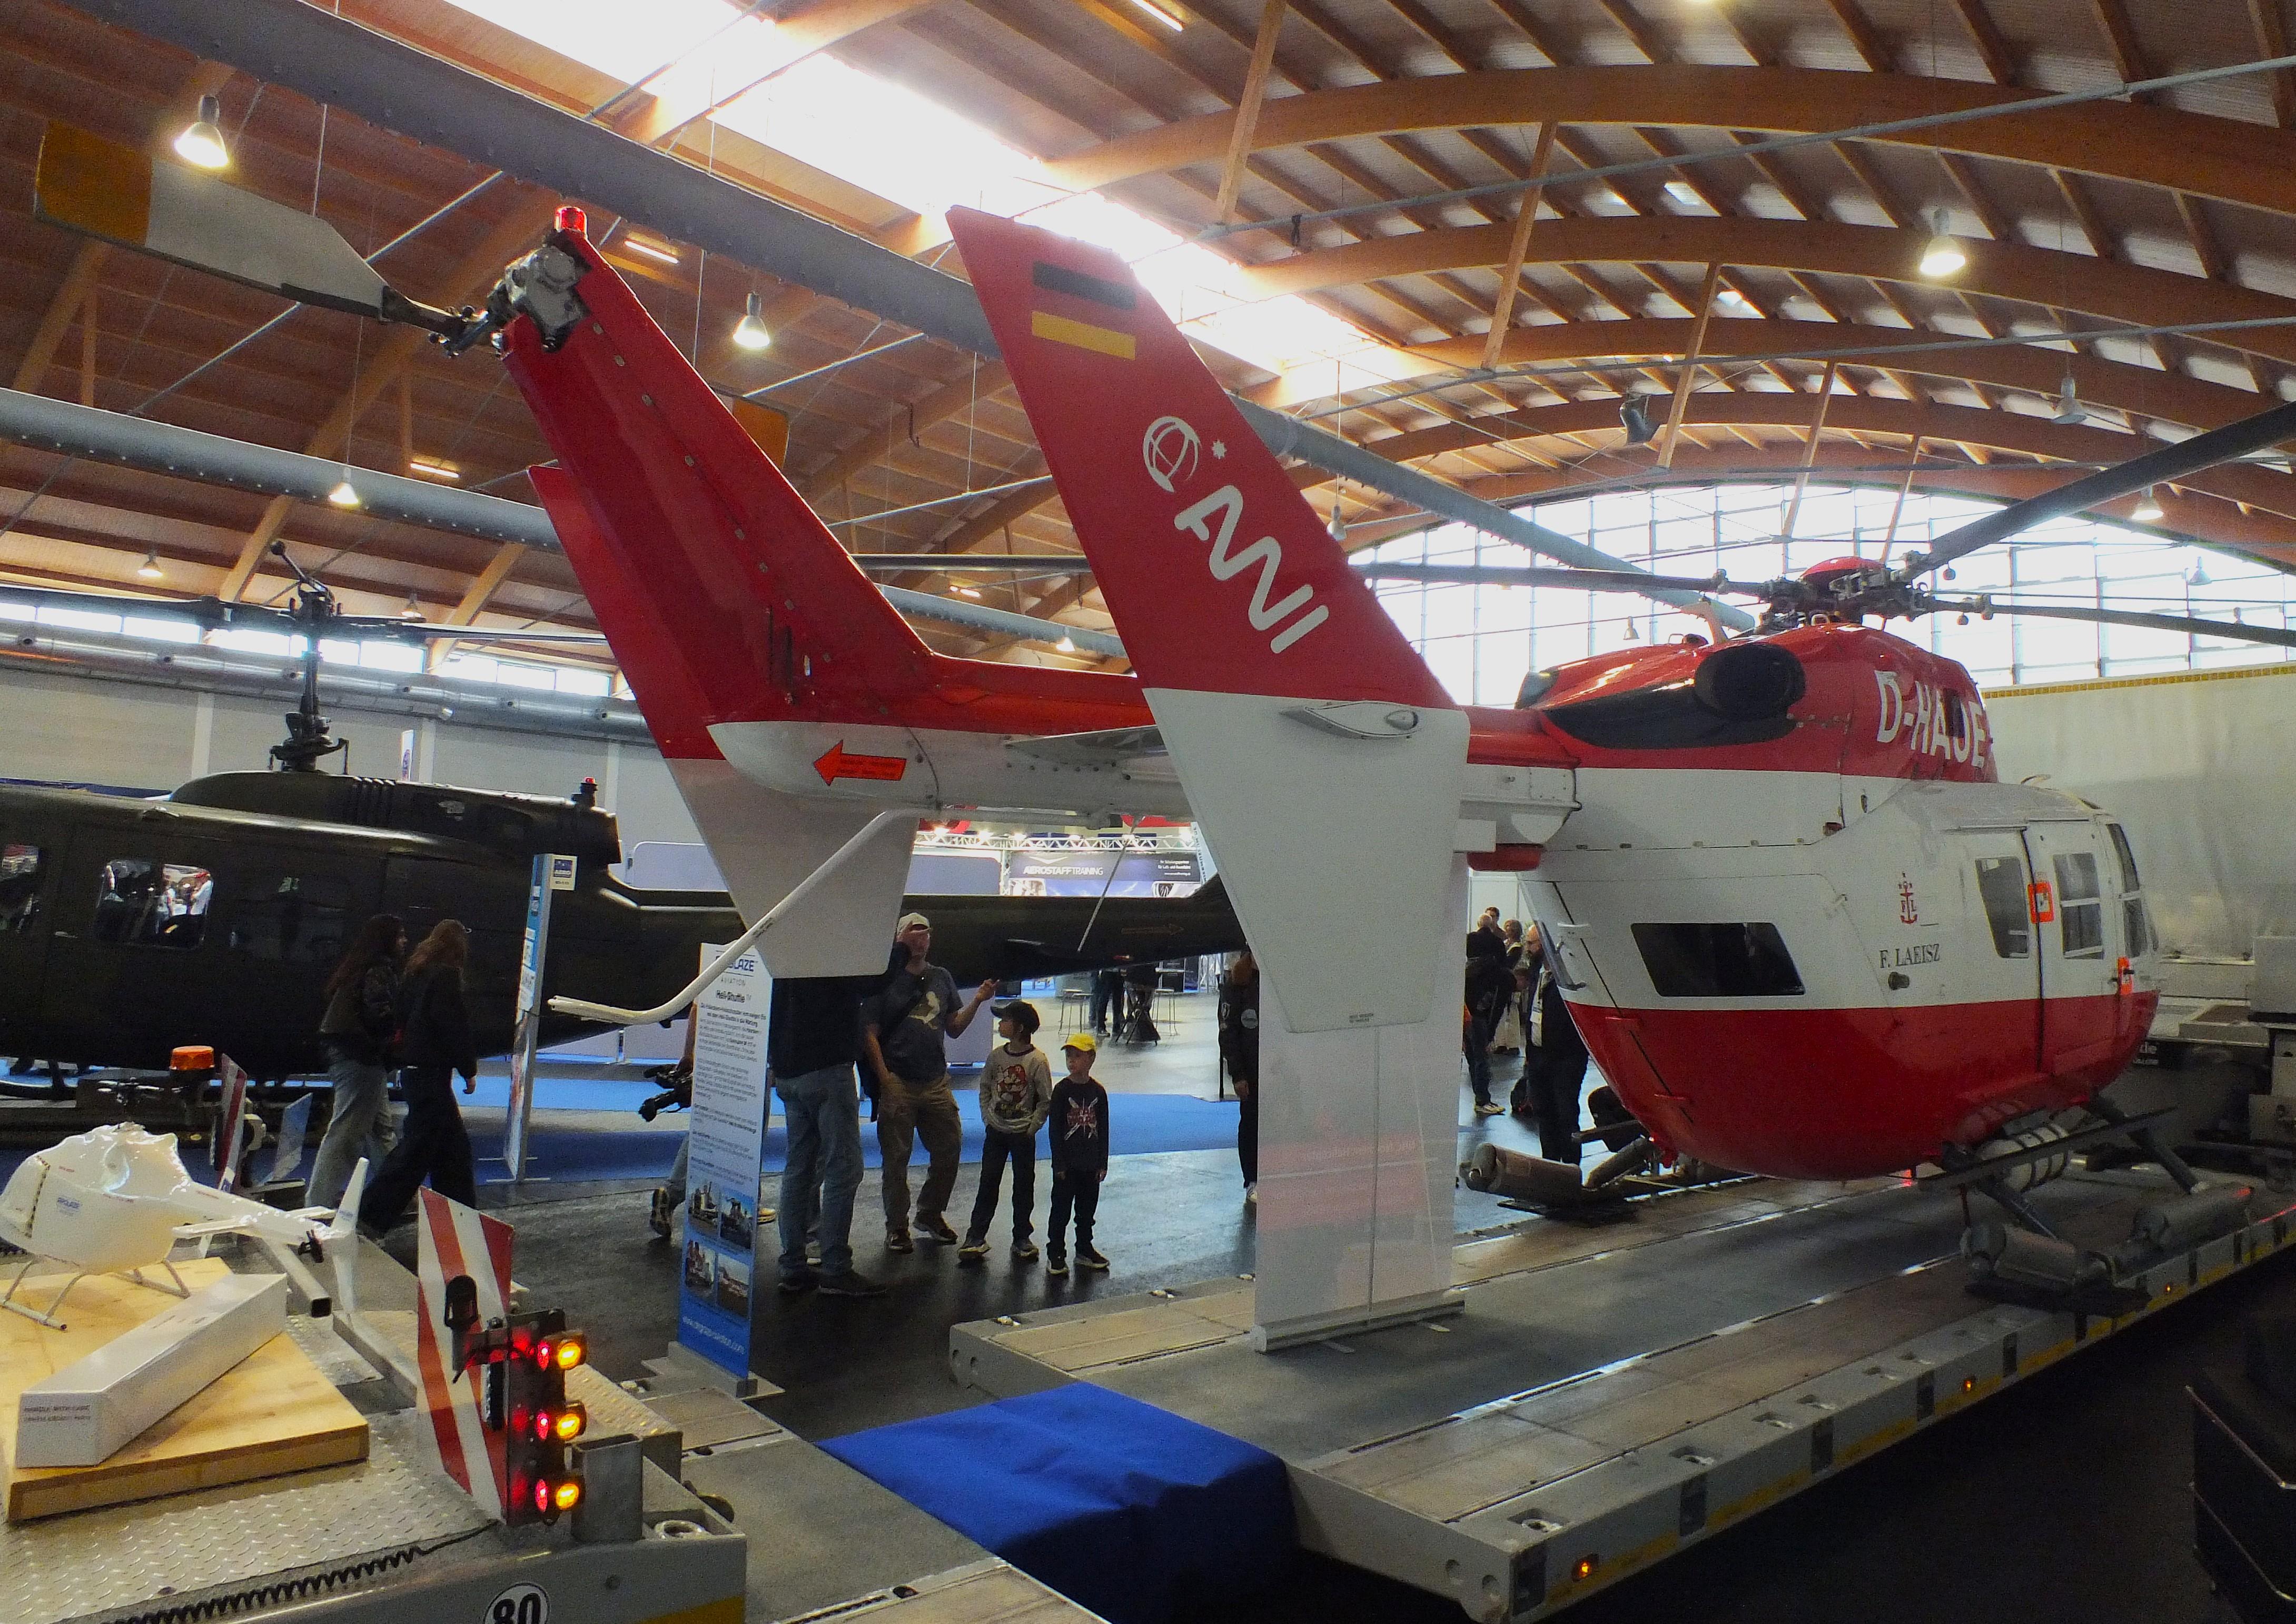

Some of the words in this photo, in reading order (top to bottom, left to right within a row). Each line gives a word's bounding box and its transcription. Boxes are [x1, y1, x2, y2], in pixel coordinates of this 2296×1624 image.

[1879, 949, 1891, 968] F.
[1896, 943, 1941, 967] LAEISZ
[493, 1592, 541, 1624] 80
